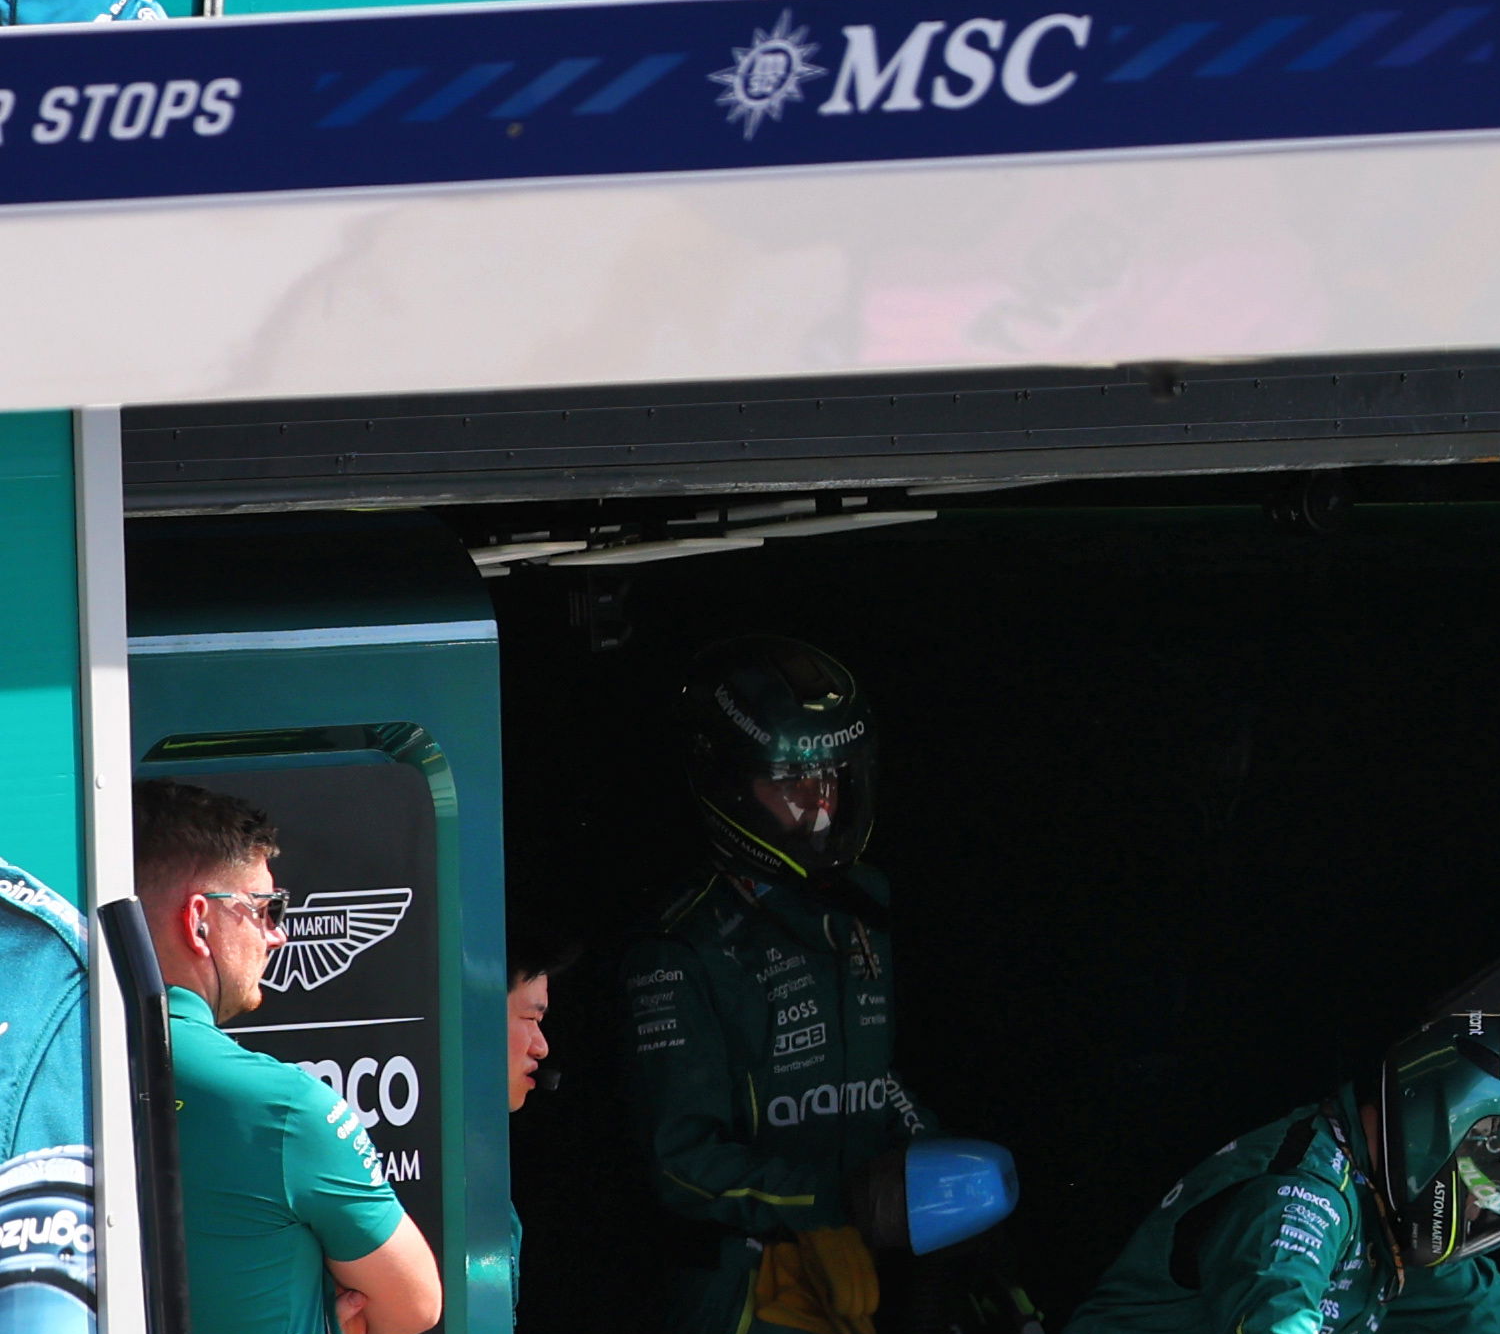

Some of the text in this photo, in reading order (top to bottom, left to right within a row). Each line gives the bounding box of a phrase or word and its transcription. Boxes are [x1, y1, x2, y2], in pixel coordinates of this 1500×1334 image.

[817, 12, 1091, 117] MSC
[32, 78, 241, 146] STOPS
[797, 719, 865, 751] aramco
[293, 914, 345, 937] MARTIN
[776, 1000, 819, 1027] BOSS
[776, 1025, 824, 1054] JCB
[1290, 1185, 1342, 1226] NexGen
[1431, 1180, 1446, 1255] ASTON MARTIN
